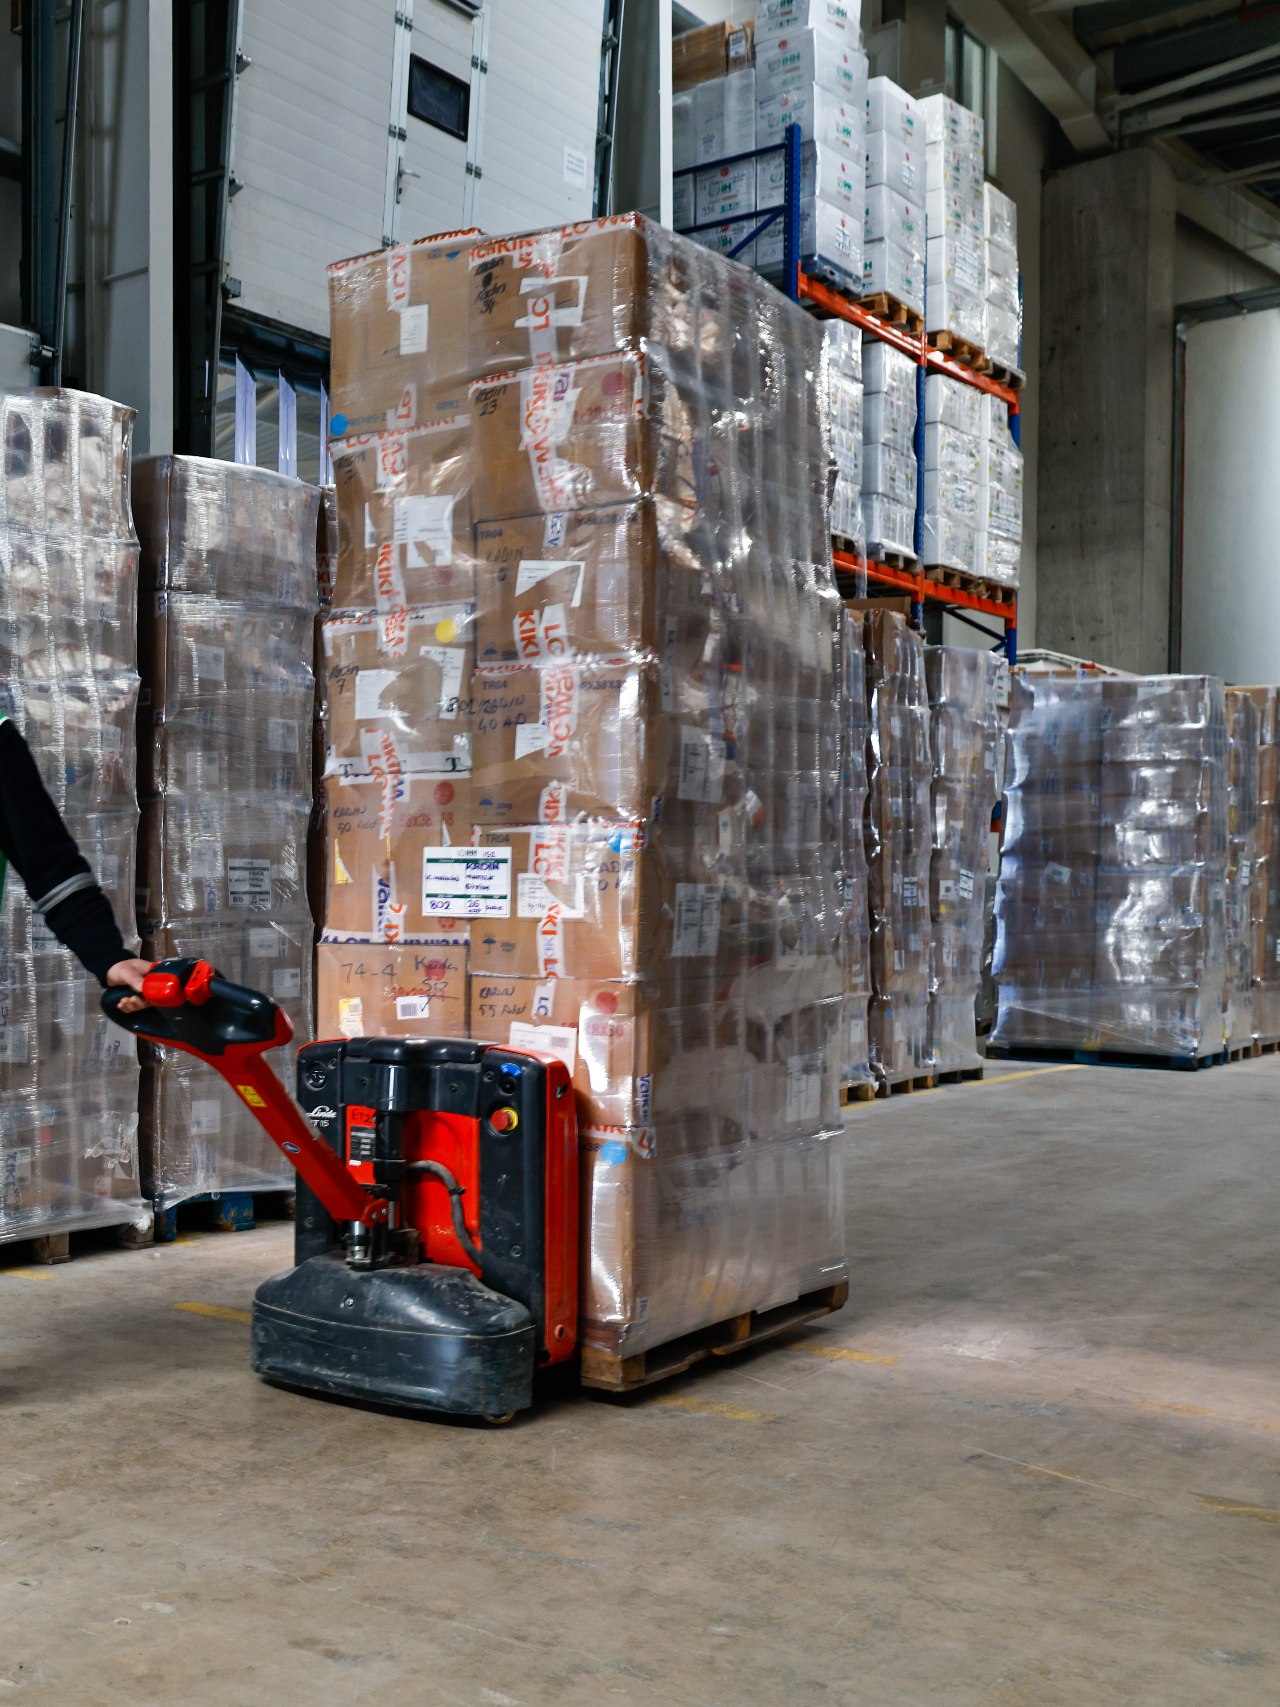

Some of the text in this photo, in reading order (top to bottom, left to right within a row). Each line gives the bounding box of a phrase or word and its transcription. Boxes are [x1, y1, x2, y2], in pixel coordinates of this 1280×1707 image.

[532, 297, 551, 331] LC
[397, 389, 412, 420] LC
[518, 610, 541, 659] KIKI
[543, 623, 565, 656] LC
[534, 843, 551, 875] LC
[536, 996, 550, 1017] LC
[305, 1105, 338, 1119] Linde
